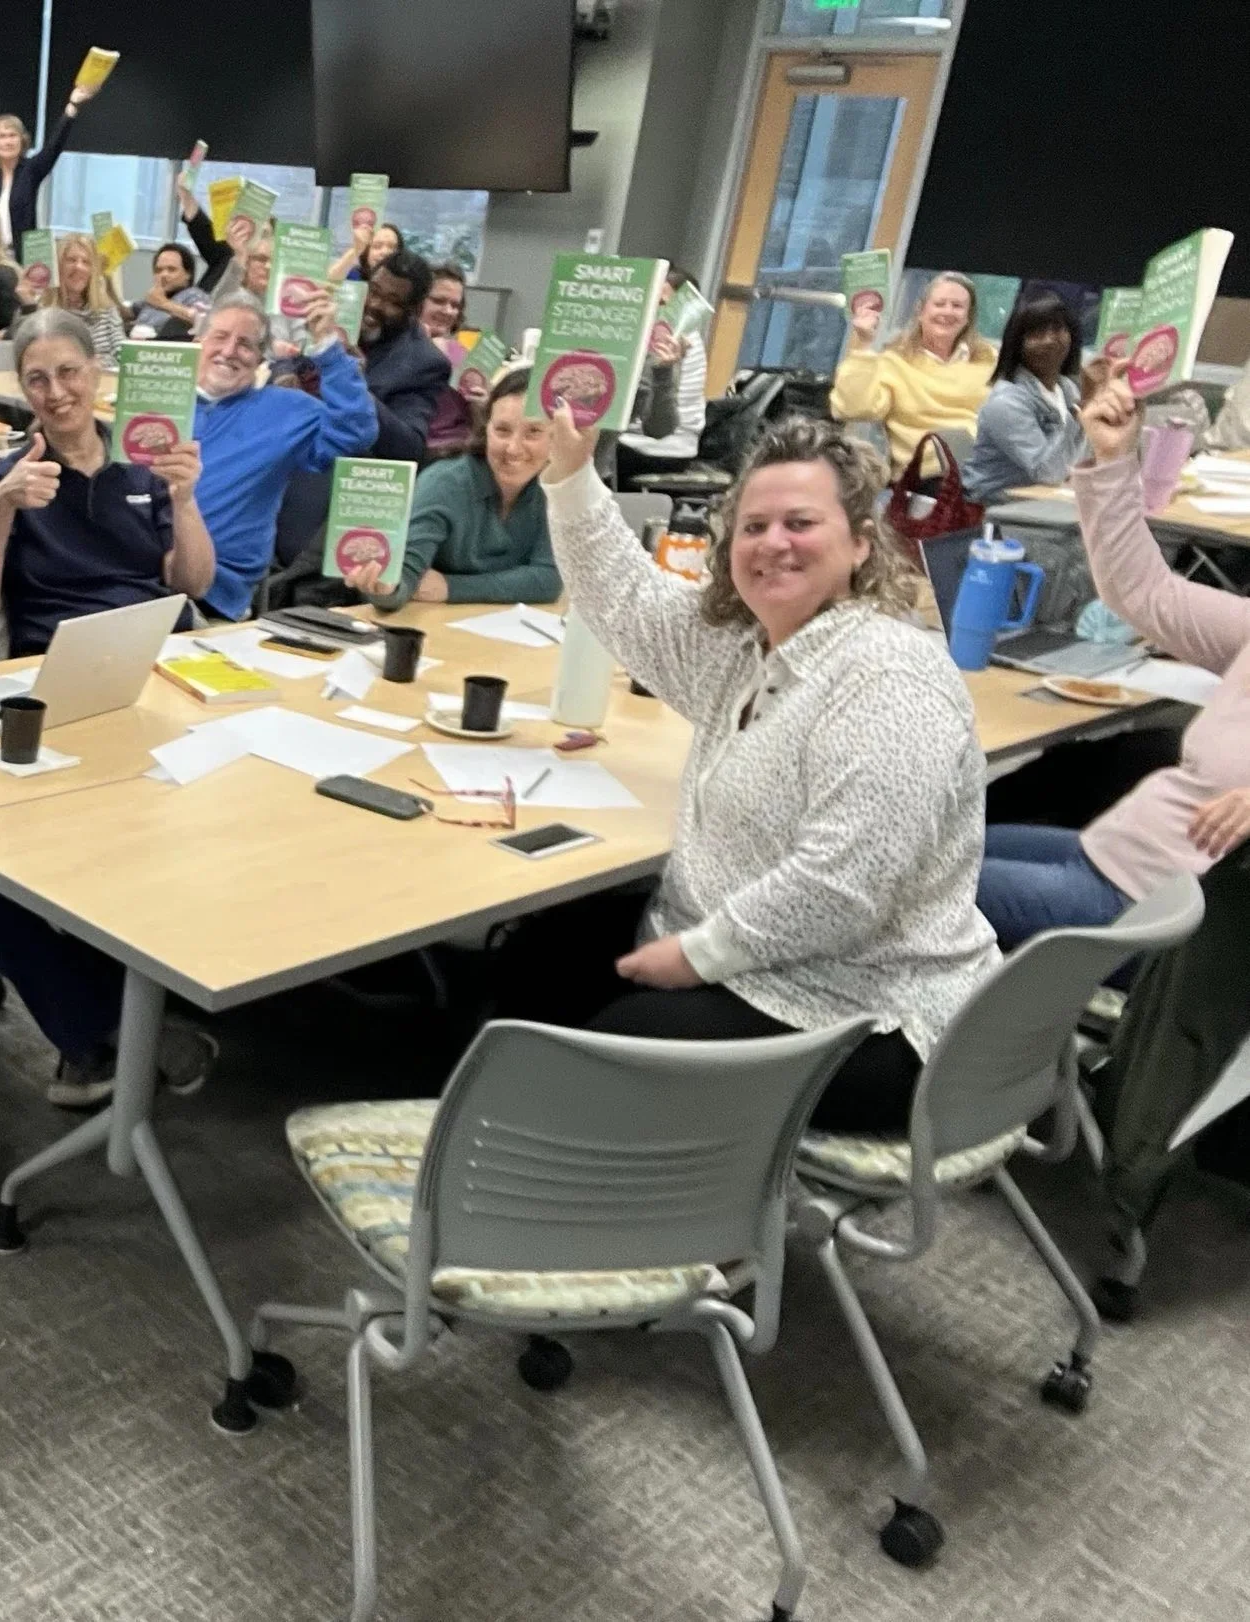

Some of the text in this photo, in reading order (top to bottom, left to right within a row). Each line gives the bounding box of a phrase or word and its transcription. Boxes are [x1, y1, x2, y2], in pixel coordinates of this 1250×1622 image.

[574, 264, 635, 283] SMART
[558, 280, 645, 303] TEACHING
[552, 301, 640, 324] STRONGER
[552, 319, 634, 341] LEARNING
[137, 349, 183, 364] SMART
[124, 362, 193, 378] TEACHING
[351, 466, 395, 480] SMART
[338, 477, 405, 494] TEACHING
